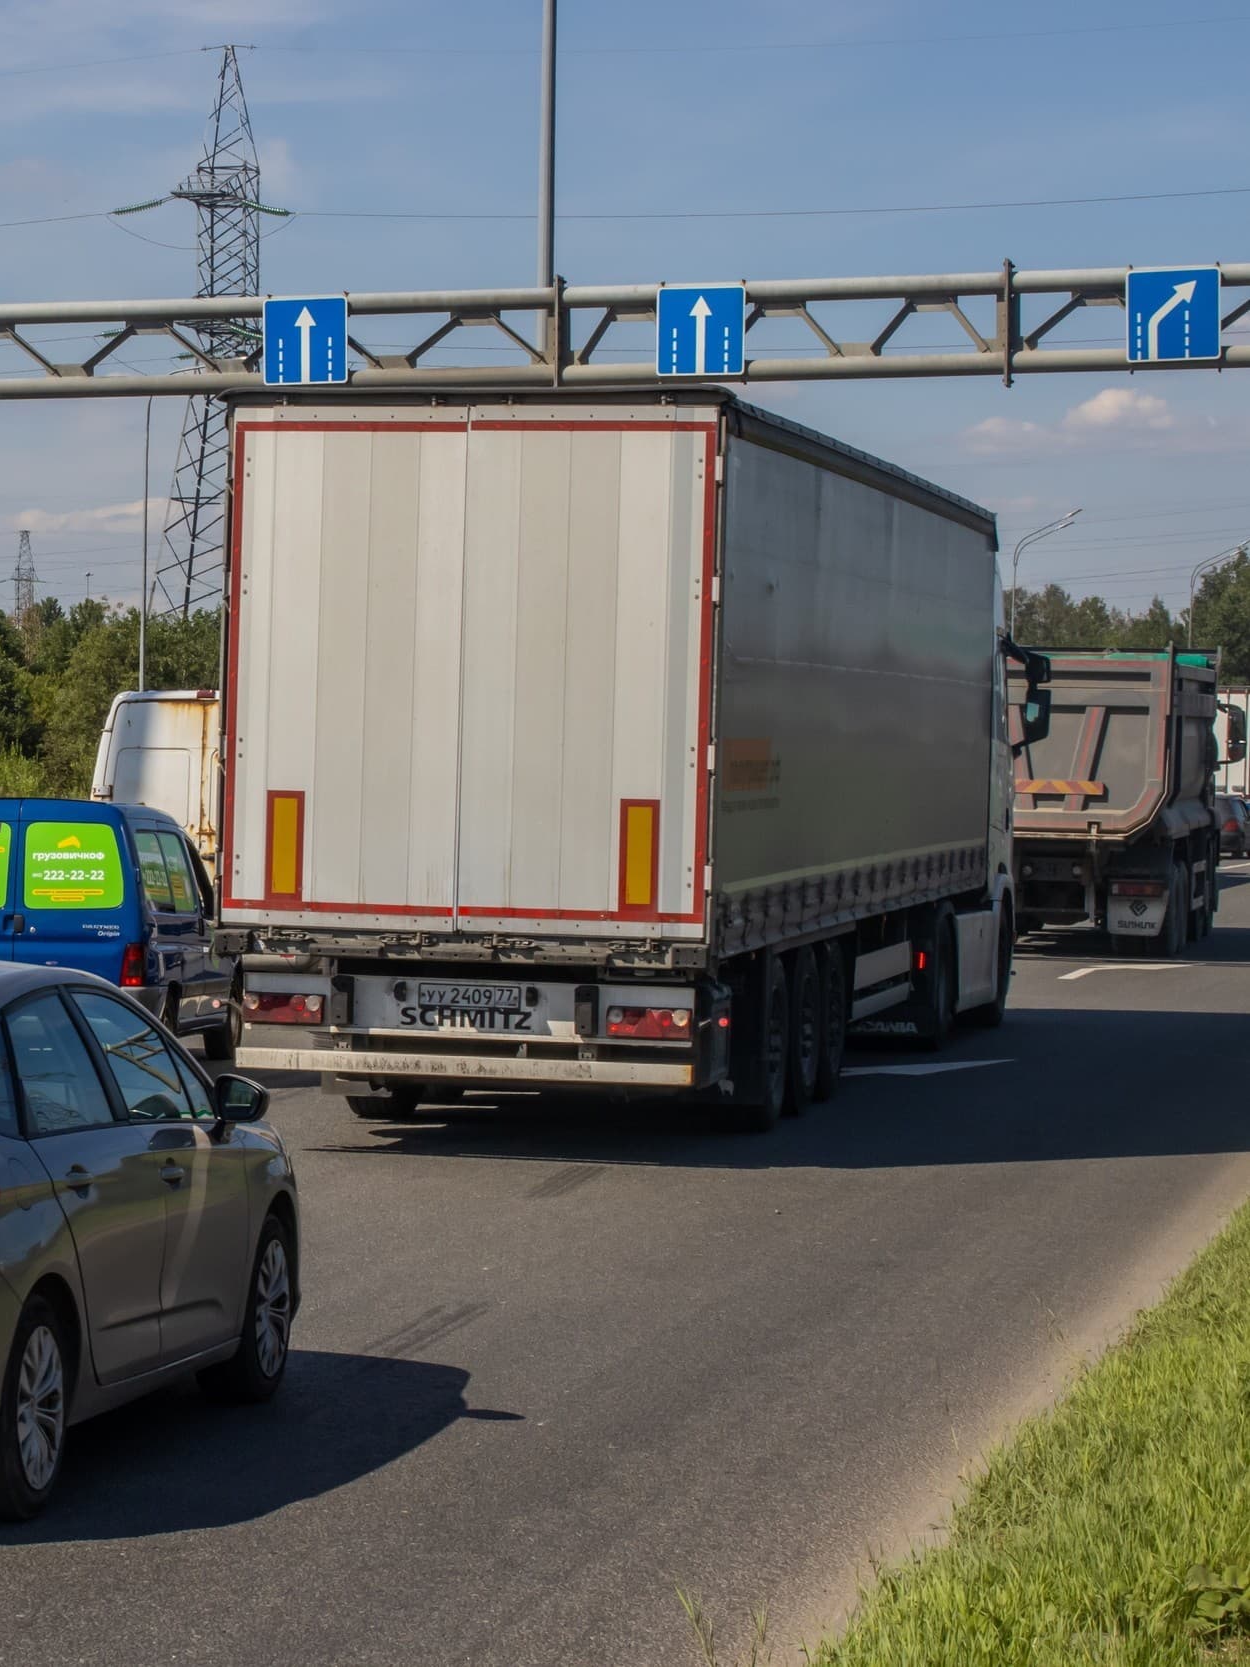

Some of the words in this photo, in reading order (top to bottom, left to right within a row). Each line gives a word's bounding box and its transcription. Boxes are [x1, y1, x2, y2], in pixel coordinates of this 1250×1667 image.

[43, 870, 105, 881] 222-22-22
[401, 1007, 532, 1030] SCHMITZ
[855, 1020, 918, 1034] CANIA
